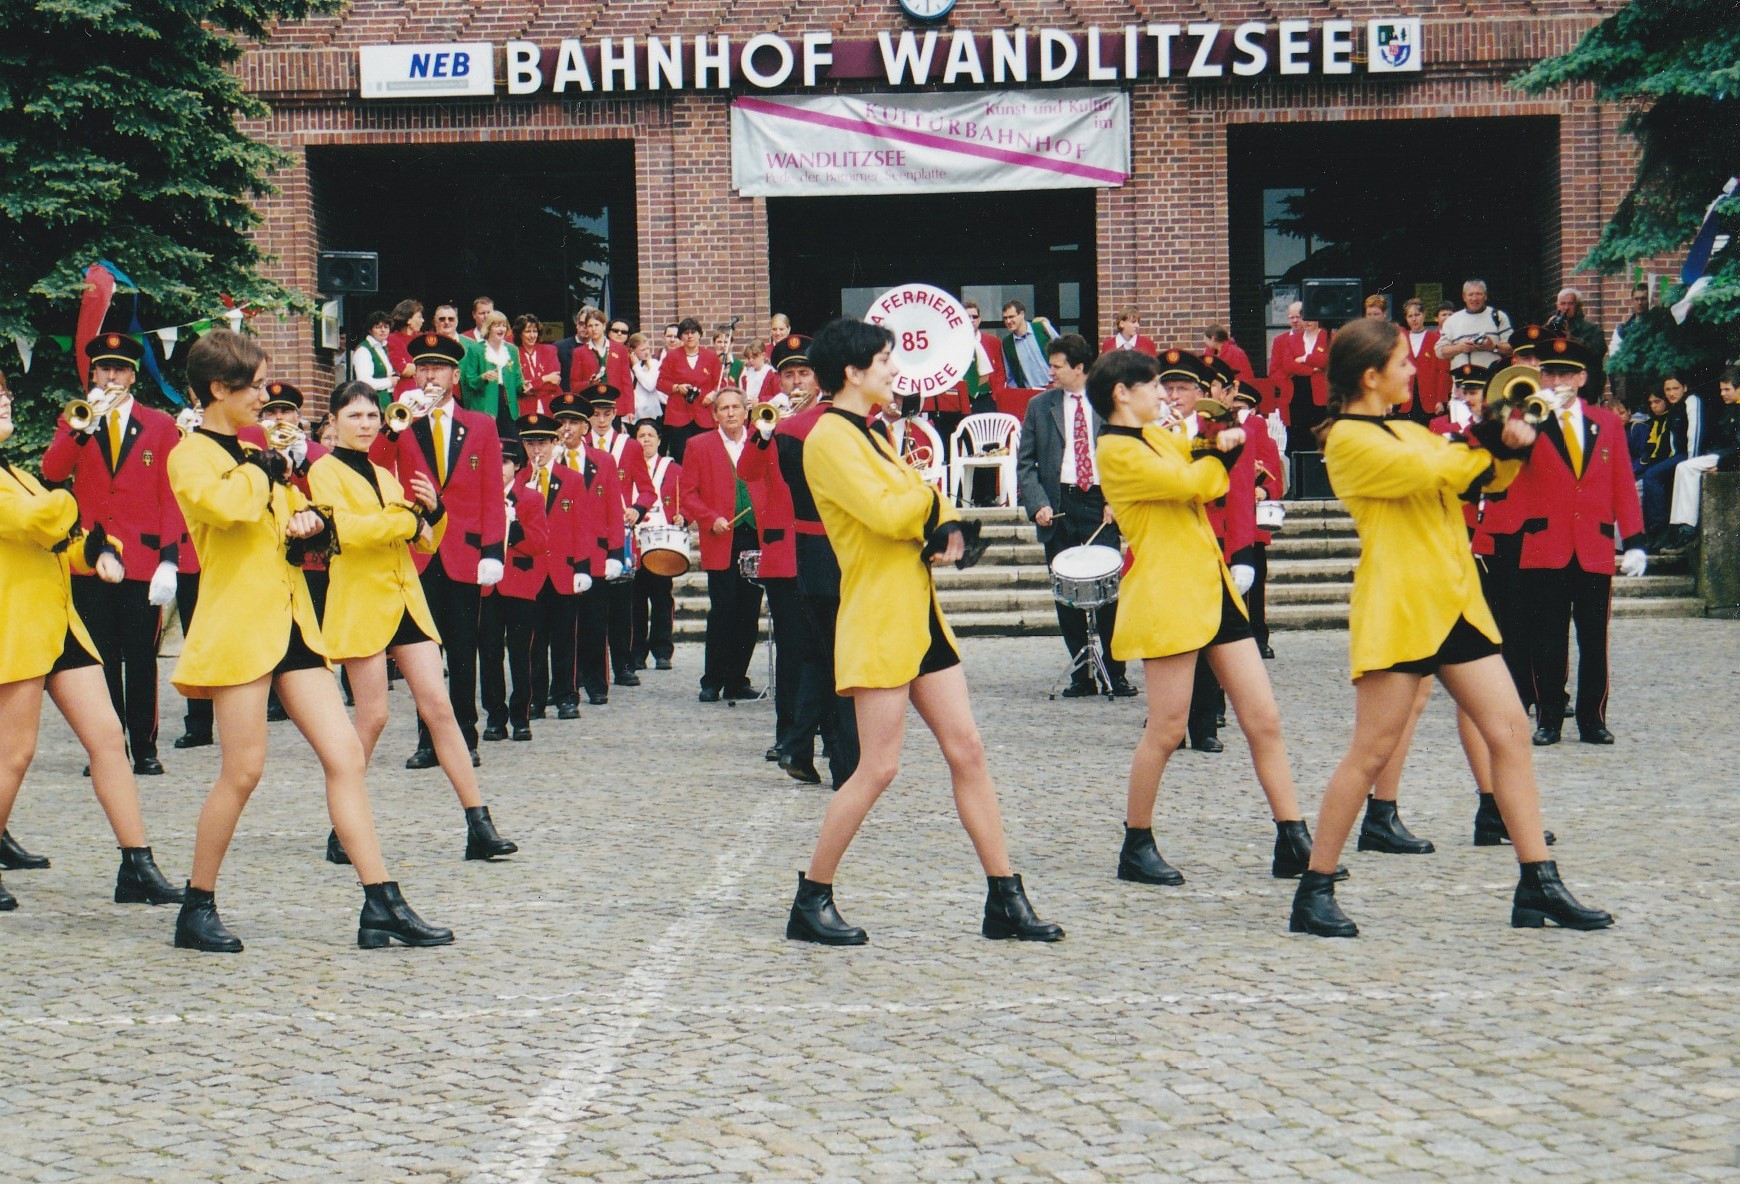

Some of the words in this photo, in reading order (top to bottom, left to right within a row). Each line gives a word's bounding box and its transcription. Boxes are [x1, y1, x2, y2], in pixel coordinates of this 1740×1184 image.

[409, 52, 470, 78] NEB
[507, 32, 833, 95] BAHNHOF
[878, 20, 1353, 86] WANDLITZSEE
[986, 102, 1026, 117] Kunst
[1034, 99, 1062, 114] und
[1094, 115, 1113, 129] im
[766, 150, 906, 169] WANDLITZSEE
[881, 290, 963, 329] FERRIERE
[902, 330, 929, 352] 85
[897, 363, 958, 393] ENDEE
